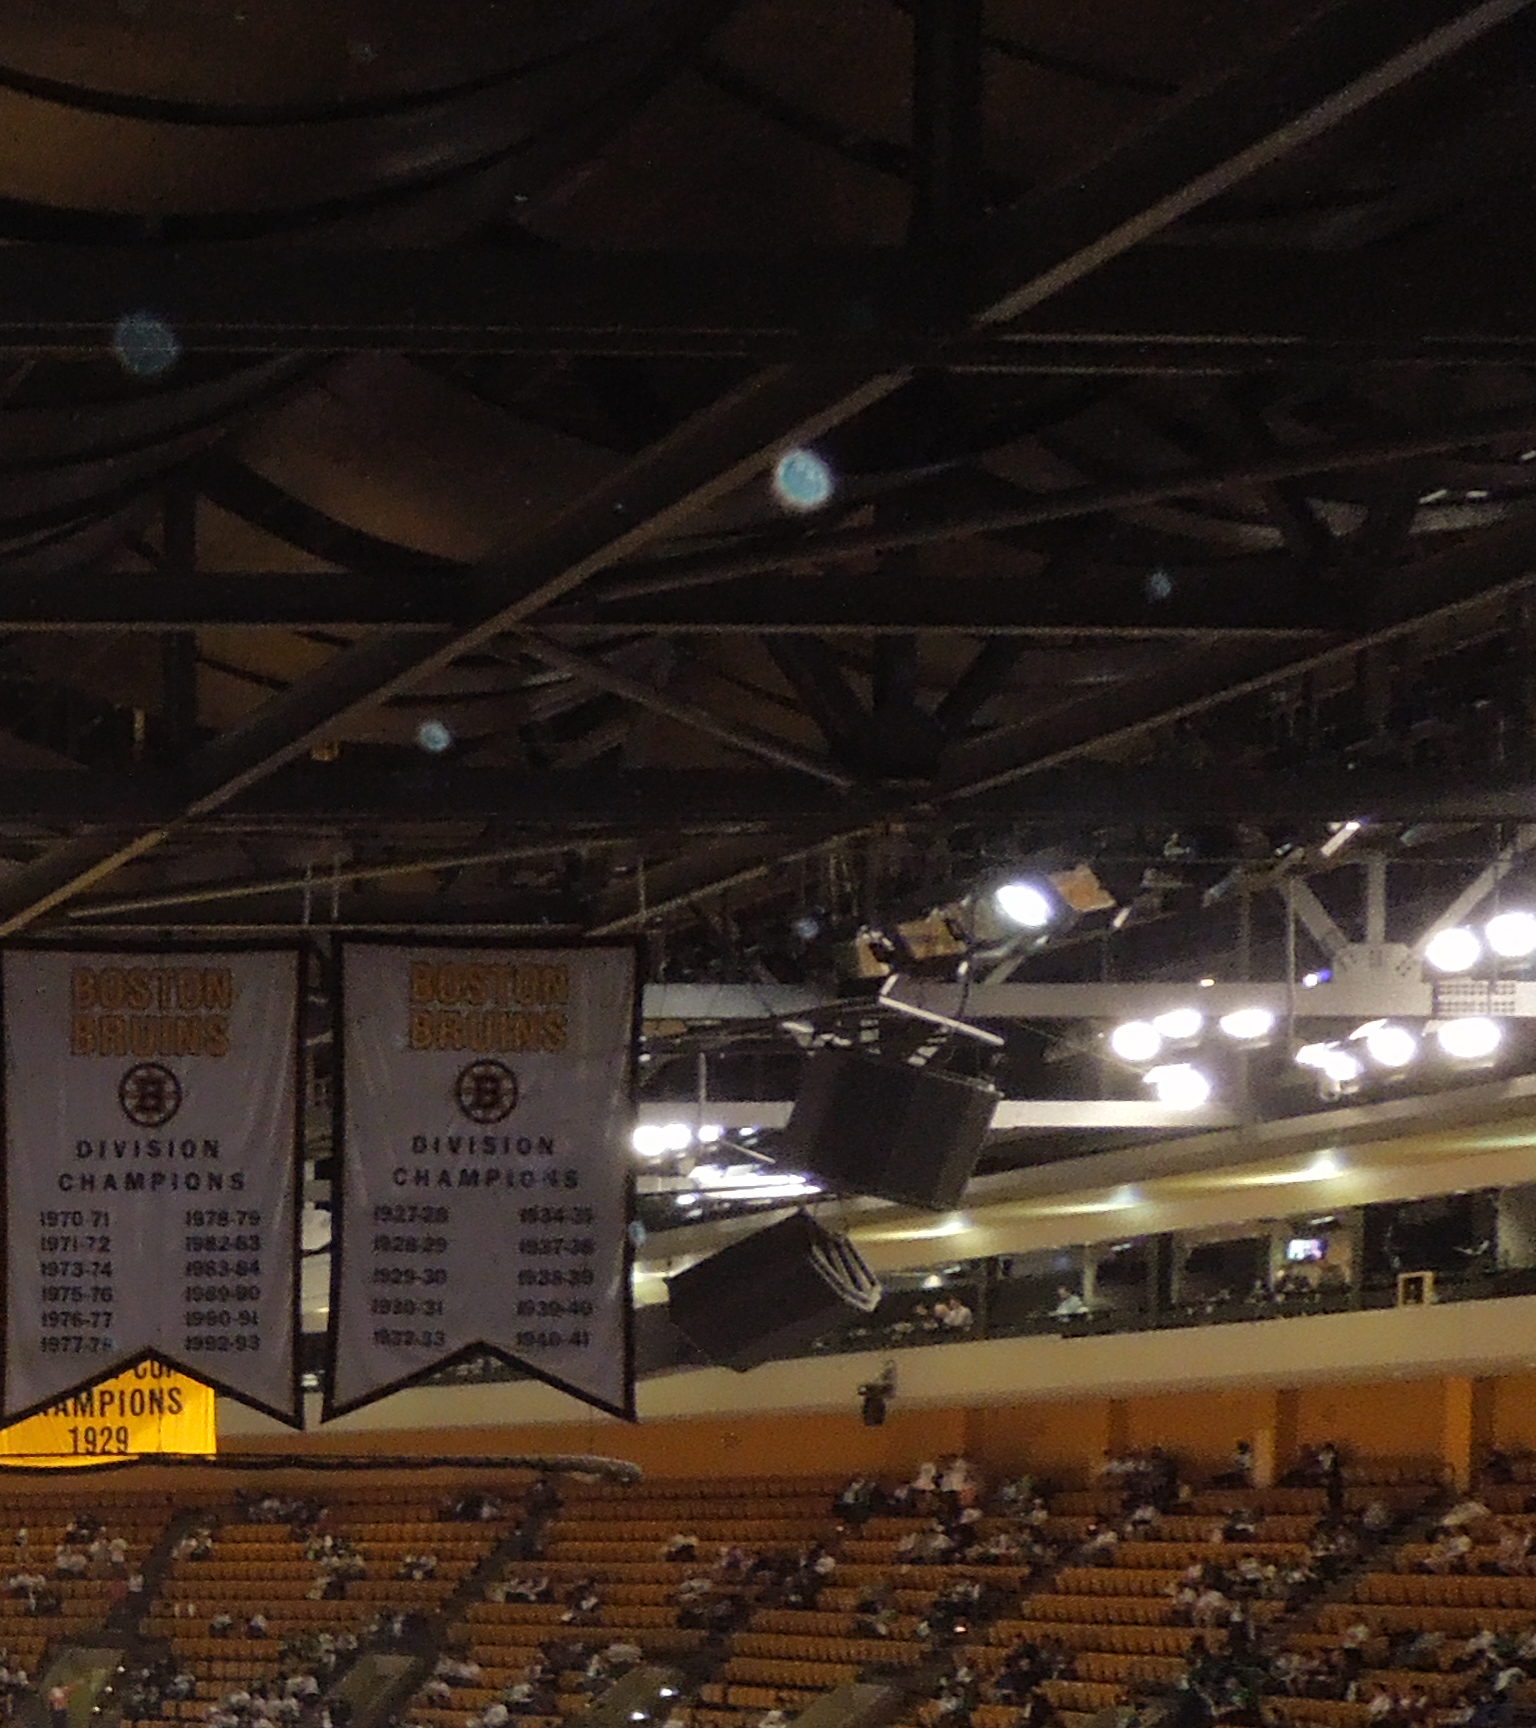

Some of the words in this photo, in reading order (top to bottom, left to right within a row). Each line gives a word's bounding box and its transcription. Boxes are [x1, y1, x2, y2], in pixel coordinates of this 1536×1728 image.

[72, 966, 231, 1010] BOSTON
[409, 962, 568, 1004] BOSTON
[71, 1014, 231, 1057] BRUINS
[408, 1009, 568, 1051] BRUINS
[76, 1139, 219, 1158] DIVISION
[412, 1135, 554, 1156] DIVISION
[58, 1172, 245, 1192] CHAMPIONS
[69, 1426, 129, 1454] 1929
